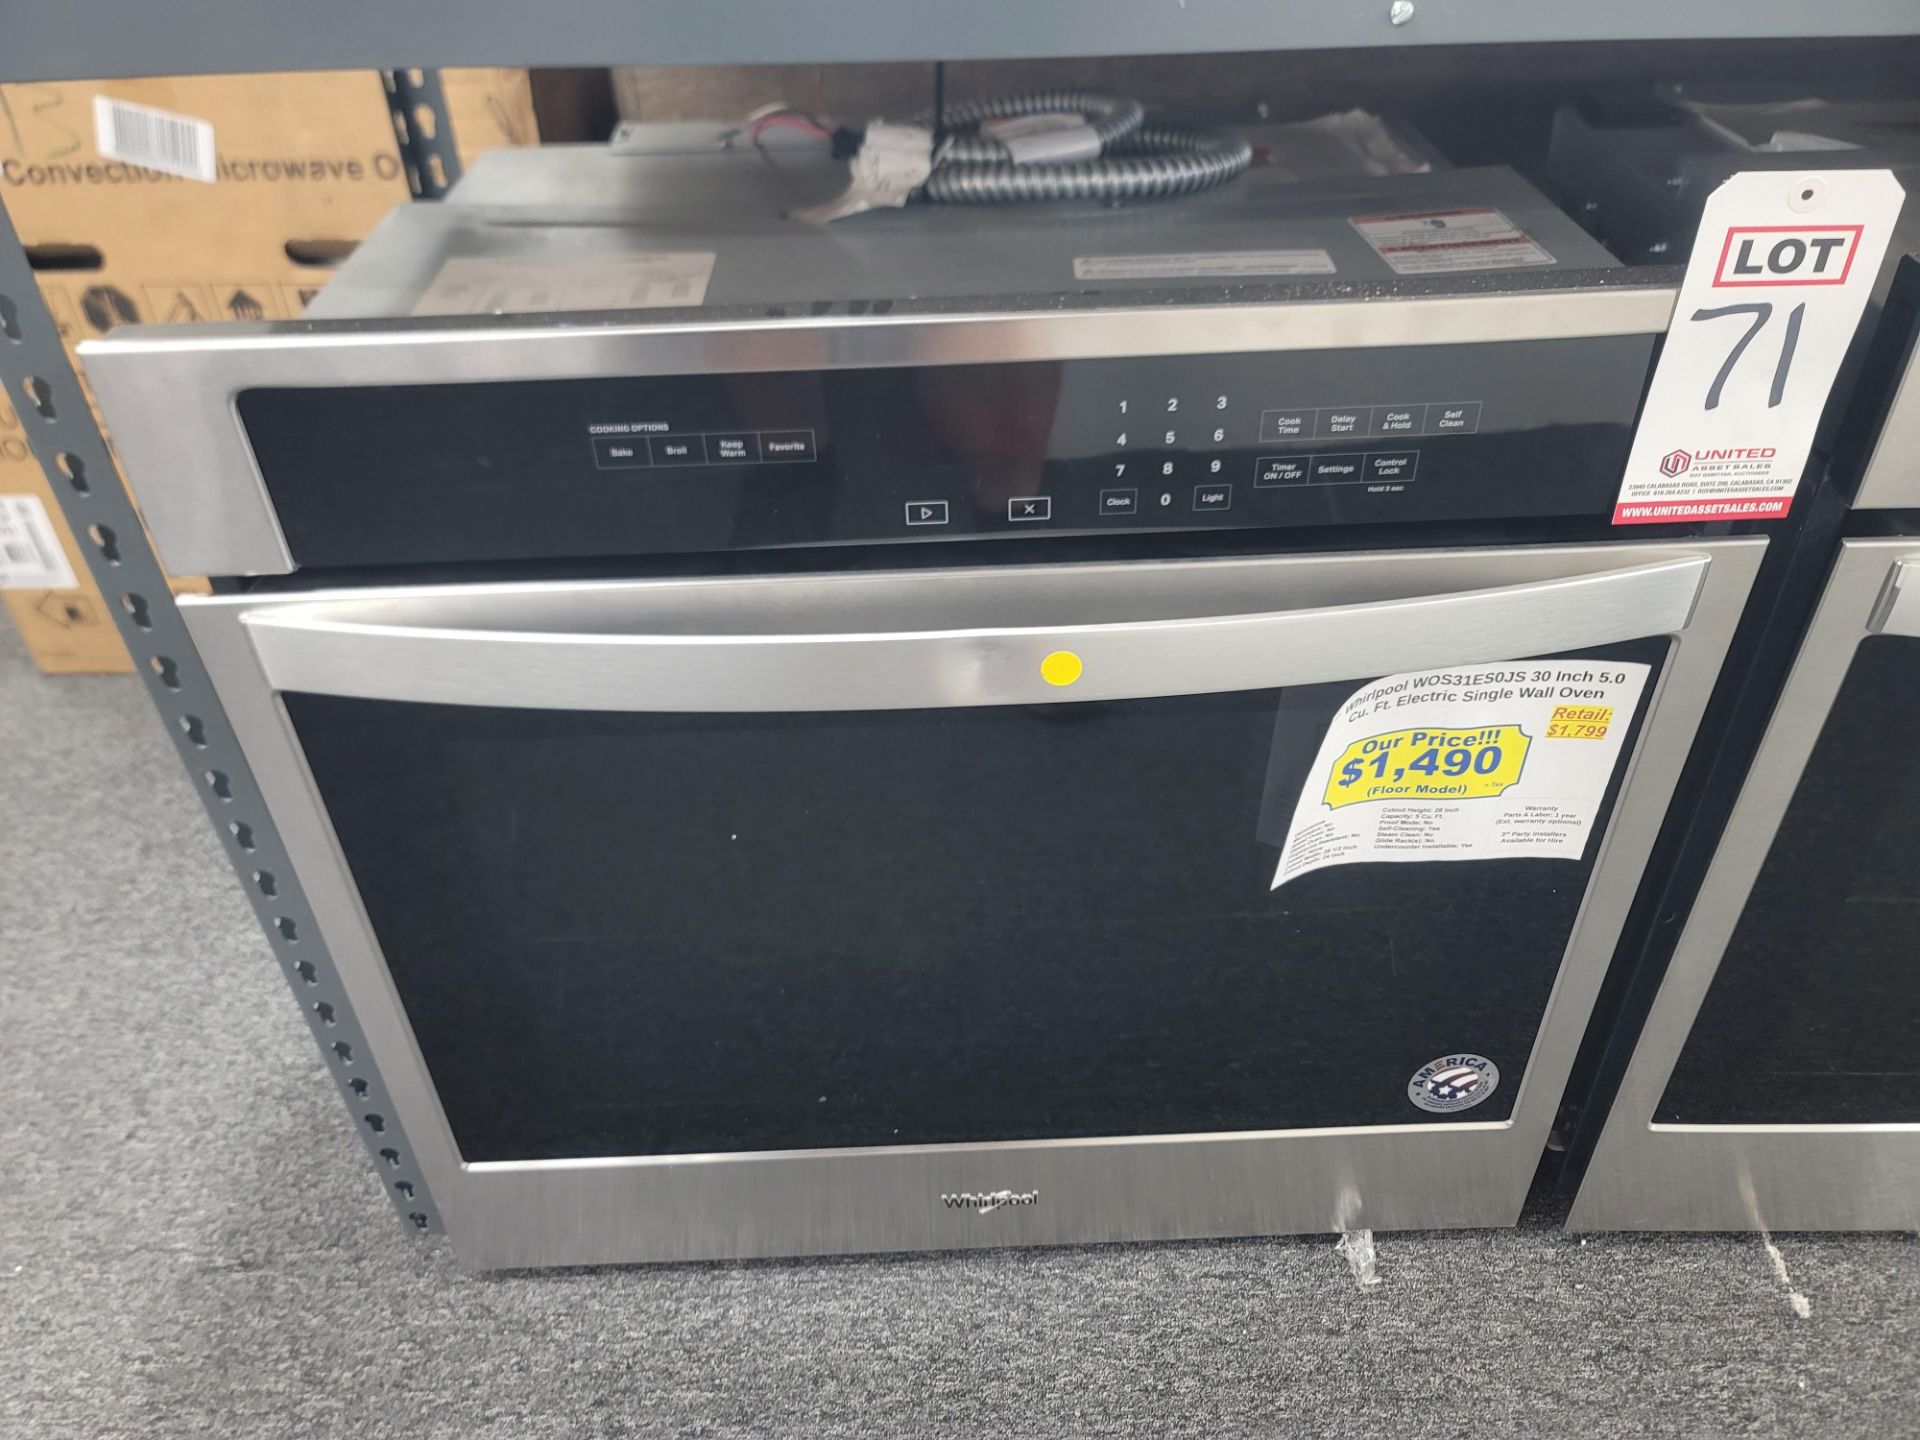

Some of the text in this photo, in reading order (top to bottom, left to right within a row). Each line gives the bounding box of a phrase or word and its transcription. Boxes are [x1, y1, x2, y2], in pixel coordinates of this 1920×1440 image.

[215, 153, 365, 182] icrowave
[1733, 238, 1846, 275] LOT
[1690, 302, 1806, 411] 71
[1119, 396, 1227, 414] 1 2 3
[1331, 415, 1356, 424] Delay
[1387, 413, 1410, 421] Cook
[1445, 410, 1462, 419] Self
[1278, 417, 1301, 426] Cook
[1382, 421, 1411, 430] & Hold
[1439, 419, 1464, 427] Clean
[588, 422, 669, 433] COOKING OPTIONS
[1278, 426, 1299, 434] Time
[1331, 424, 1353, 432] Start
[1116, 428, 1224, 446] 4 5 6
[720, 440, 743, 449] Keep
[769, 441, 805, 451] Favorite
[609, 448, 633, 457] Bake
[665, 446, 688, 455] Broil
[719, 449, 746, 457] Warm
[1695, 448, 1776, 460] UNITED
[1272, 463, 1297, 471] Timer
[1375, 458, 1407, 467] Control
[1115, 460, 1221, 477] 7 8 9
[1318, 465, 1354, 474] Settings
[1378, 467, 1400, 475] Lock
[1263, 472, 1277, 480] ON
[1284, 470, 1302, 479] OFF
[1107, 497, 1131, 506] Clock
[1160, 493, 1171, 506] 0
[1202, 493, 1224, 503] Light
[1622, 502, 1783, 518] WWW.UNITEDASSETSALES.COM
[1345, 681, 1409, 714] Whirlpool
[1531, 671, 1551, 682] 30
[1556, 671, 1594, 683] Inch
[1600, 672, 1626, 684] 5.0
[1348, 687, 1605, 722] Cu. Ft. Electric Single Wall Oven
[1552, 707, 1612, 721] Retail:
[1547, 724, 1608, 738] $1,799
[1362, 730, 1501, 754] Our Price!!!
[1338, 746, 1502, 788] $1,490
[1367, 784, 1467, 797] (Floor Model)
[1413, 1057, 1487, 1088] AMERICA
[941, 1190, 1039, 1210] Whirlpool
